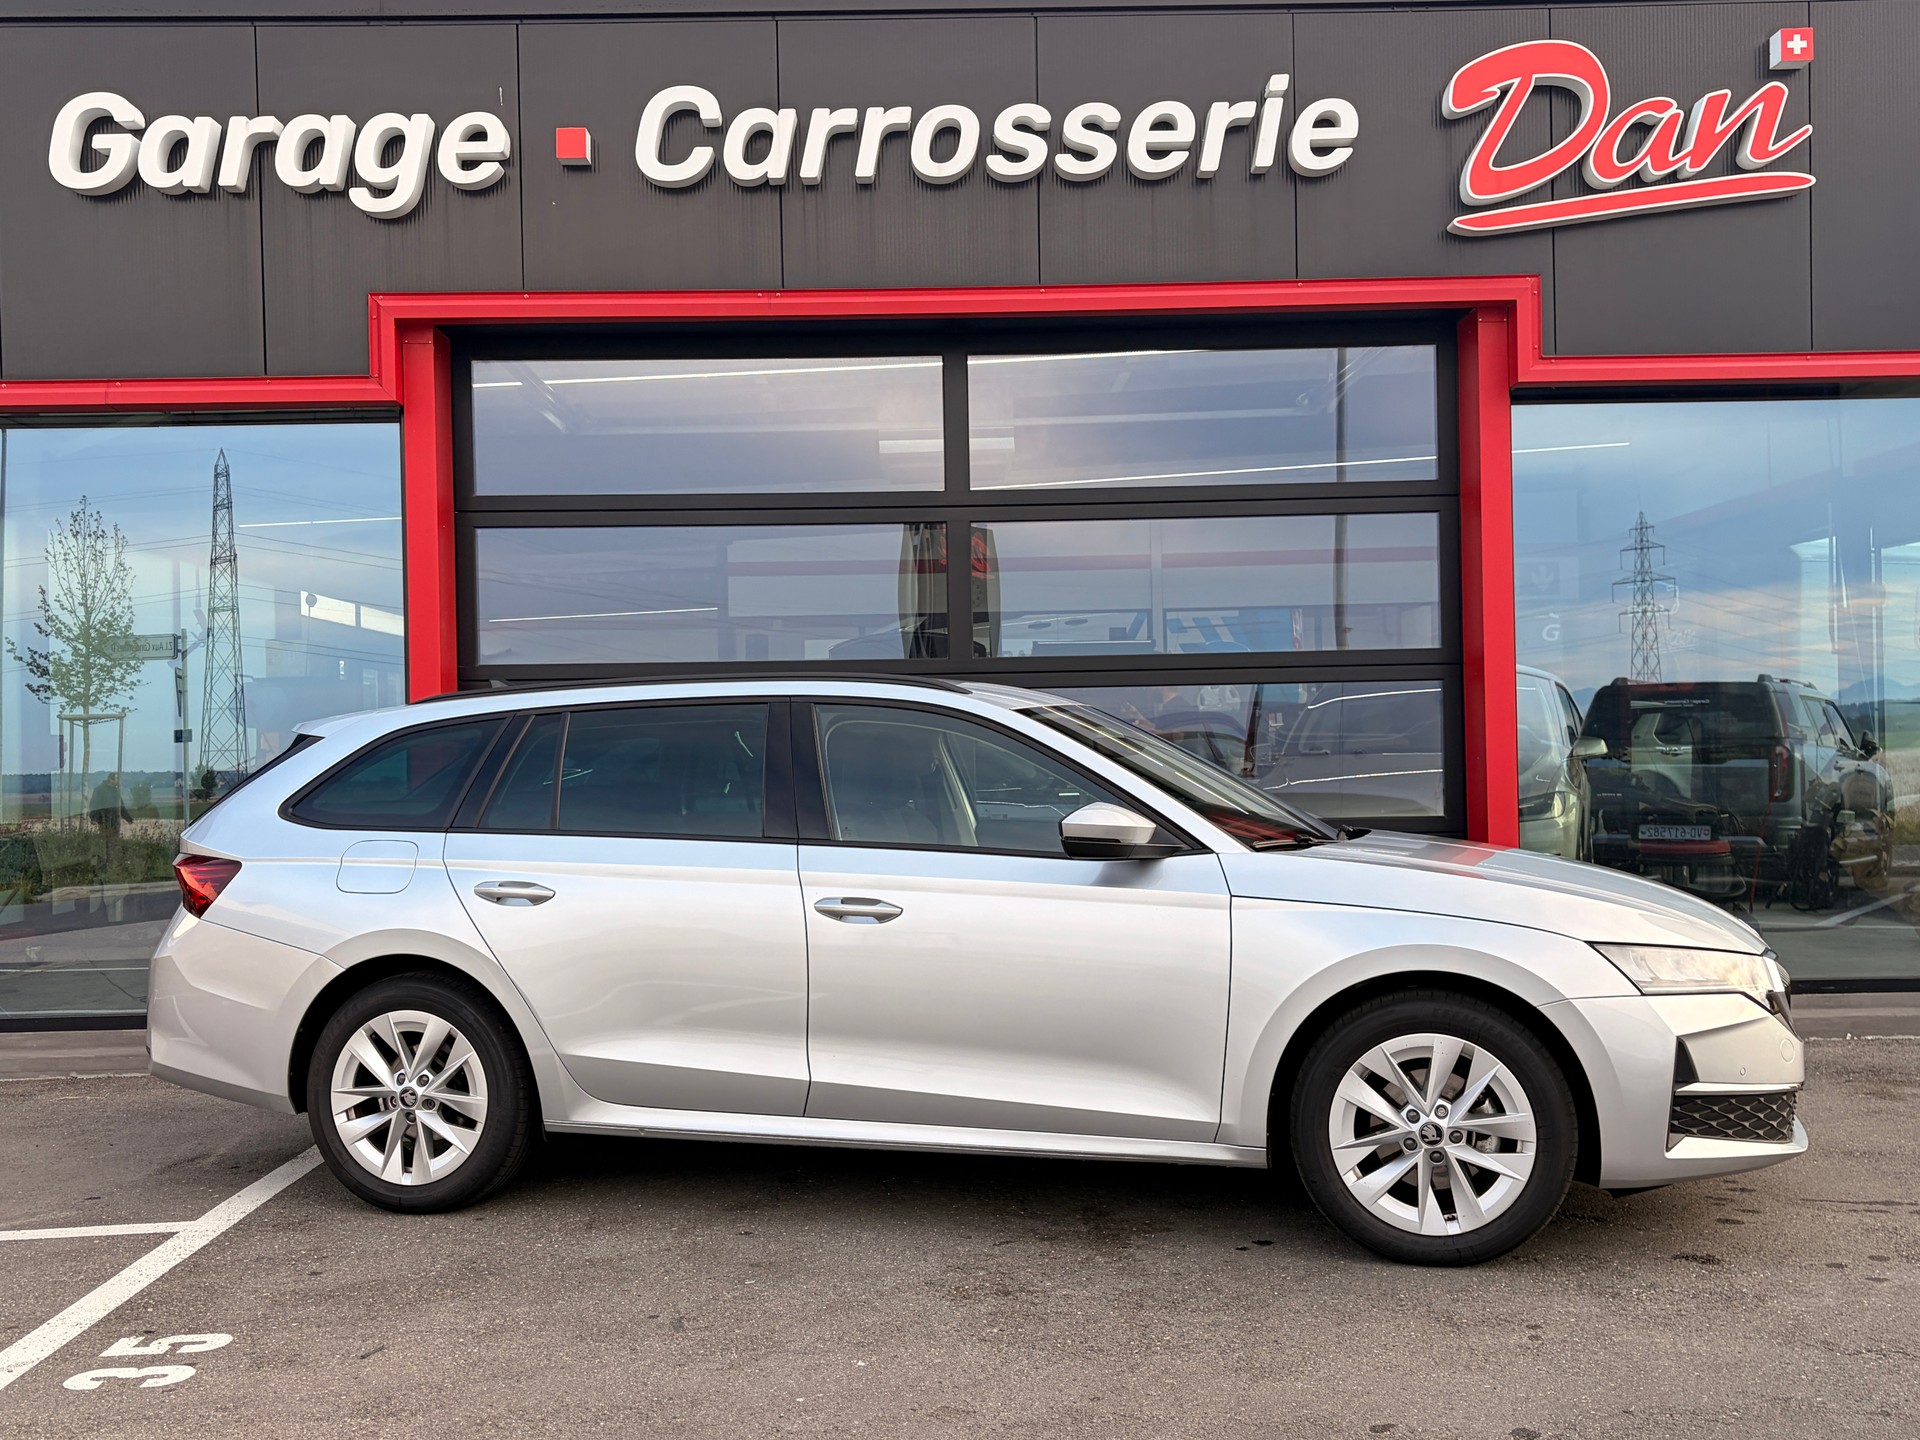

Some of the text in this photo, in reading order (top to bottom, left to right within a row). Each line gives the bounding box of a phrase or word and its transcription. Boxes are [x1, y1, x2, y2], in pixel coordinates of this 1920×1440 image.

[48, 39, 1814, 219] Garage Carrosserie Dan
[62, 1333, 234, 1391] 35
